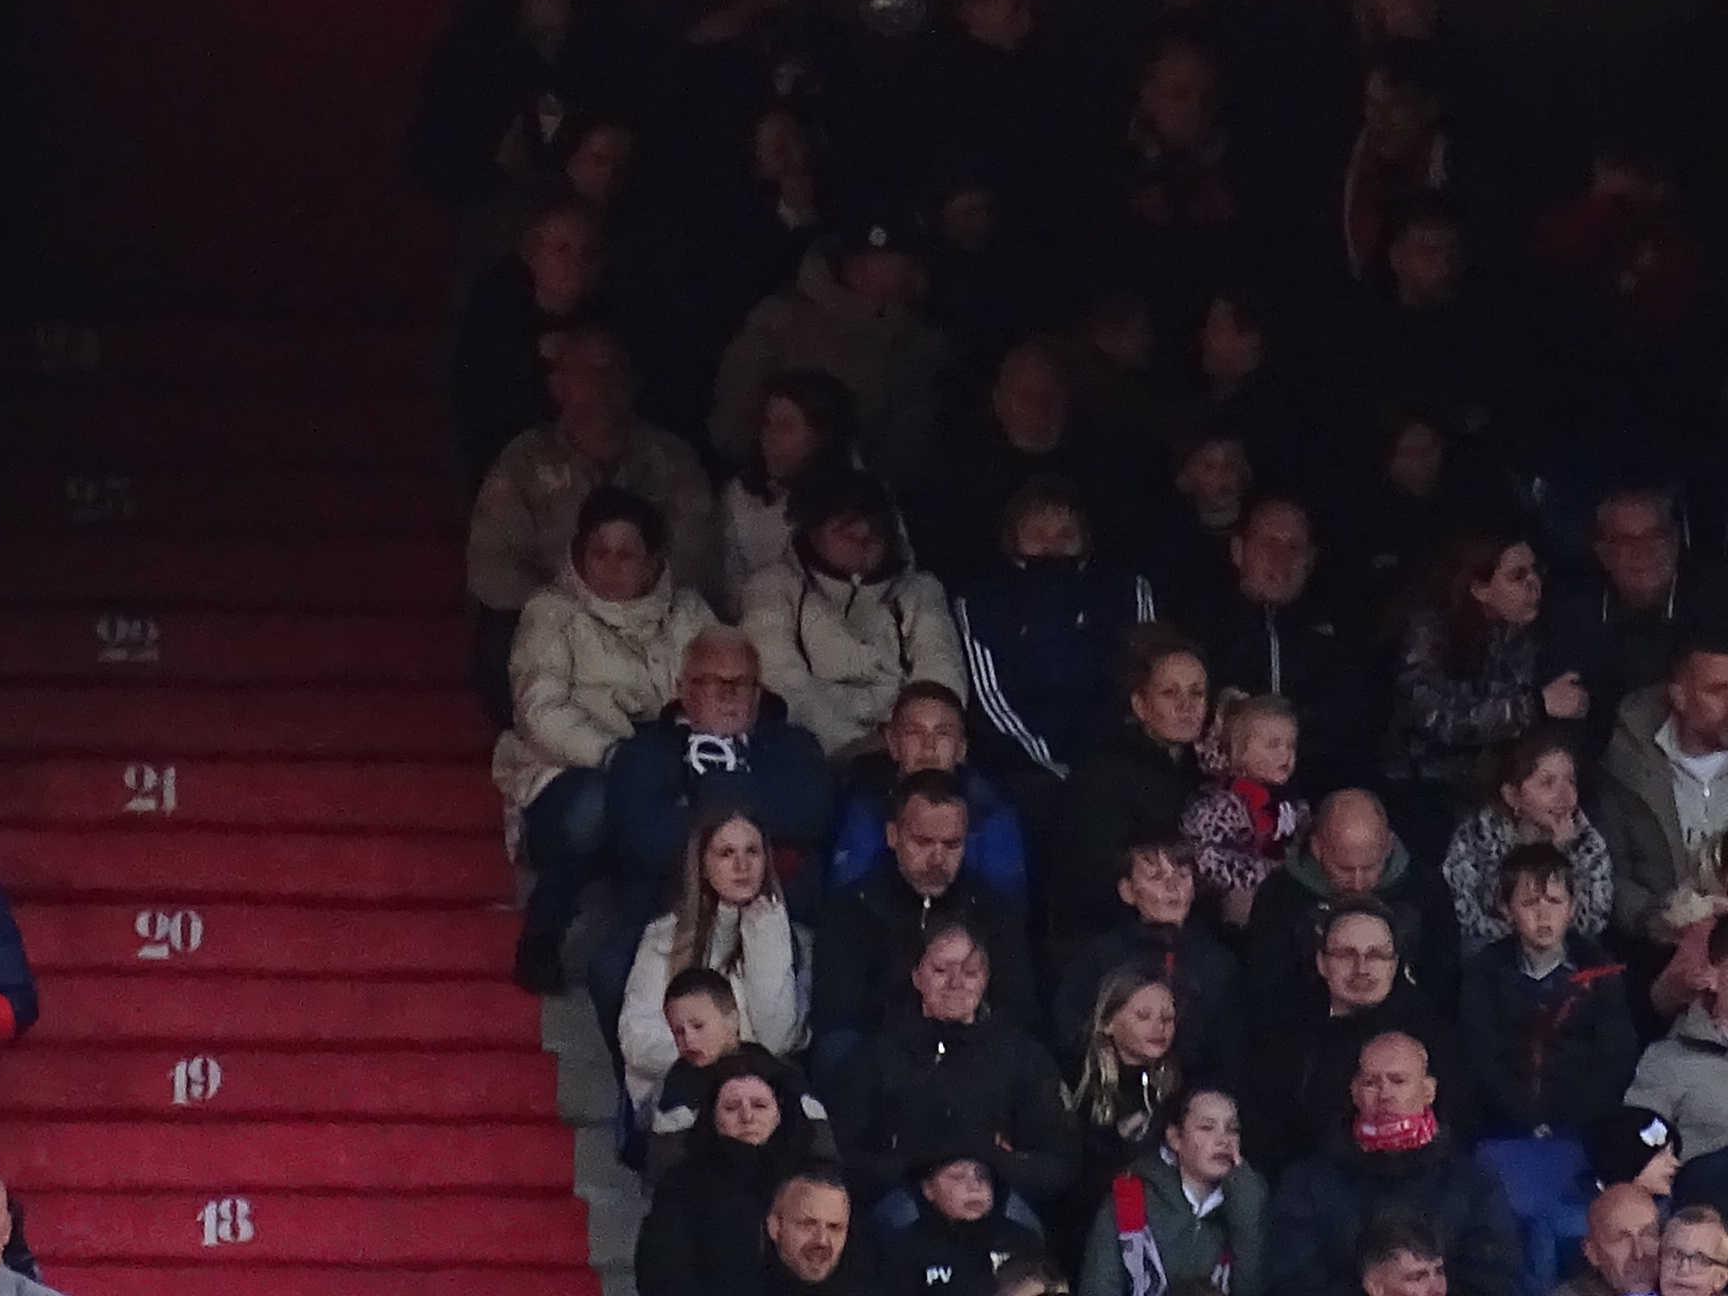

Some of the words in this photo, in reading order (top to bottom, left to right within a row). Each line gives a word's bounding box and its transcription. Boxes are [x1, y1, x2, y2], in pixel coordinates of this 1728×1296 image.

[123, 764, 178, 817] 21
[134, 910, 204, 960] 20
[170, 1055, 223, 1107] 19
[196, 1197, 256, 1247] 18
